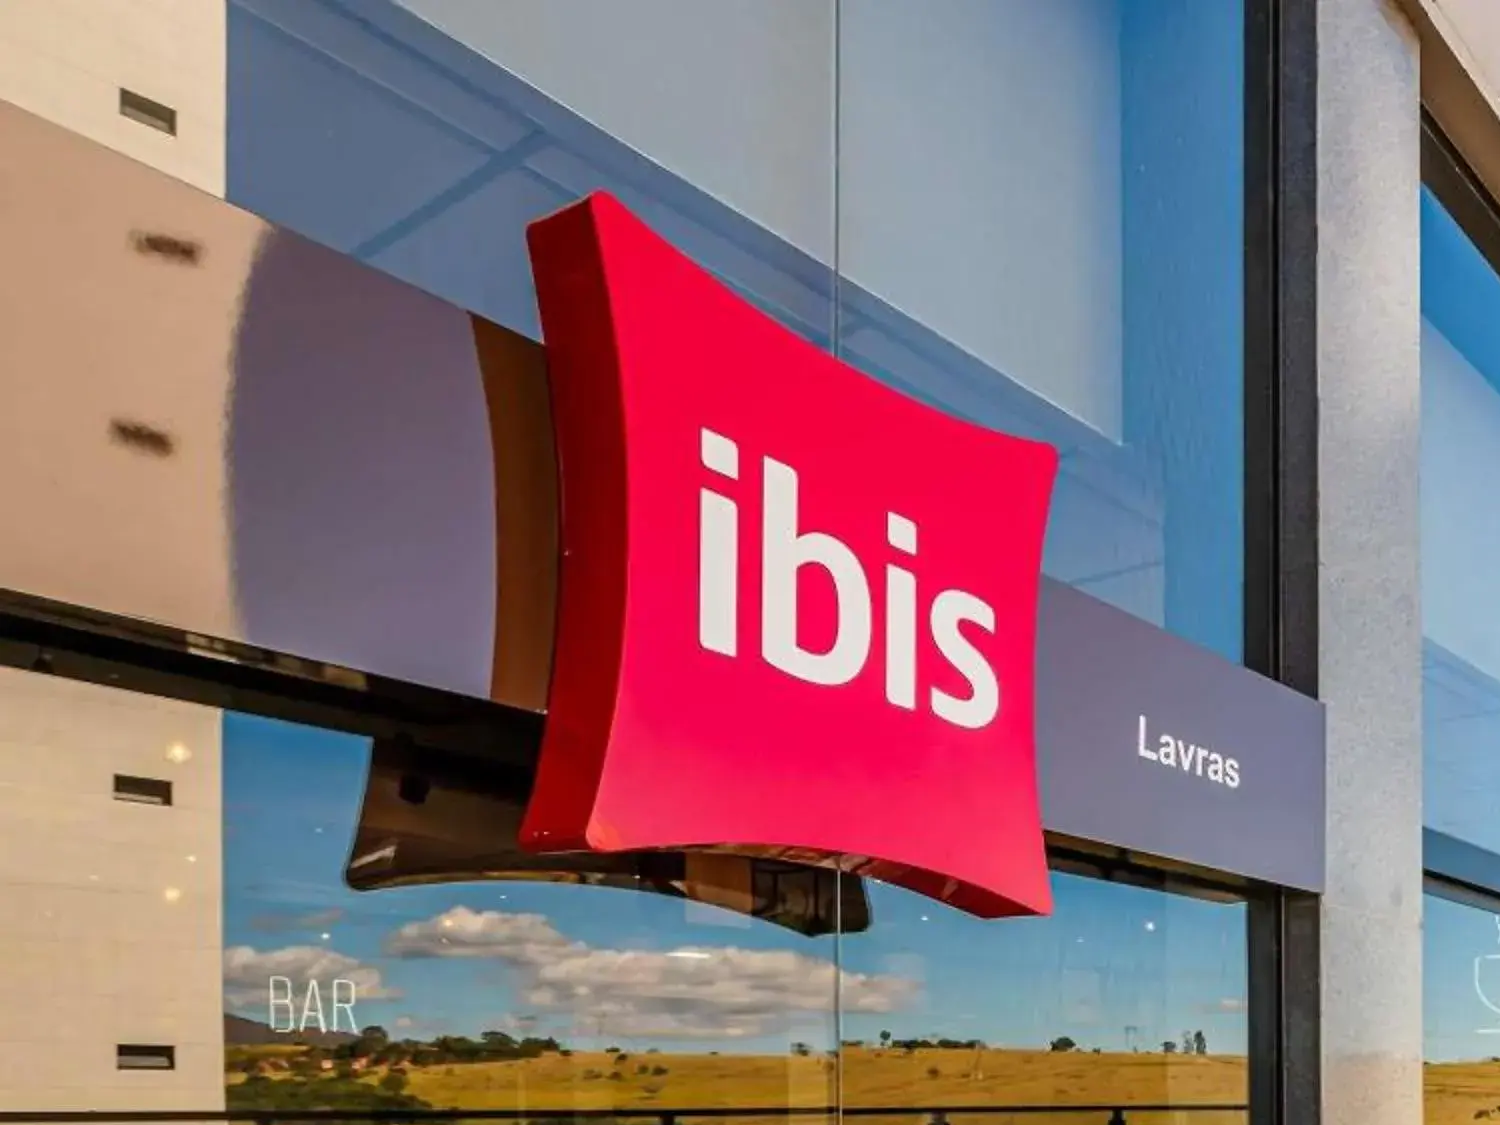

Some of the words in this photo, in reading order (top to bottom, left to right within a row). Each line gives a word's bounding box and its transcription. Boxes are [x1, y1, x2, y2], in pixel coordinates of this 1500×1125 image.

[700, 426, 999, 729] ibis
[1138, 714, 1240, 789] Lavras
[269, 975, 361, 1035] BAR
